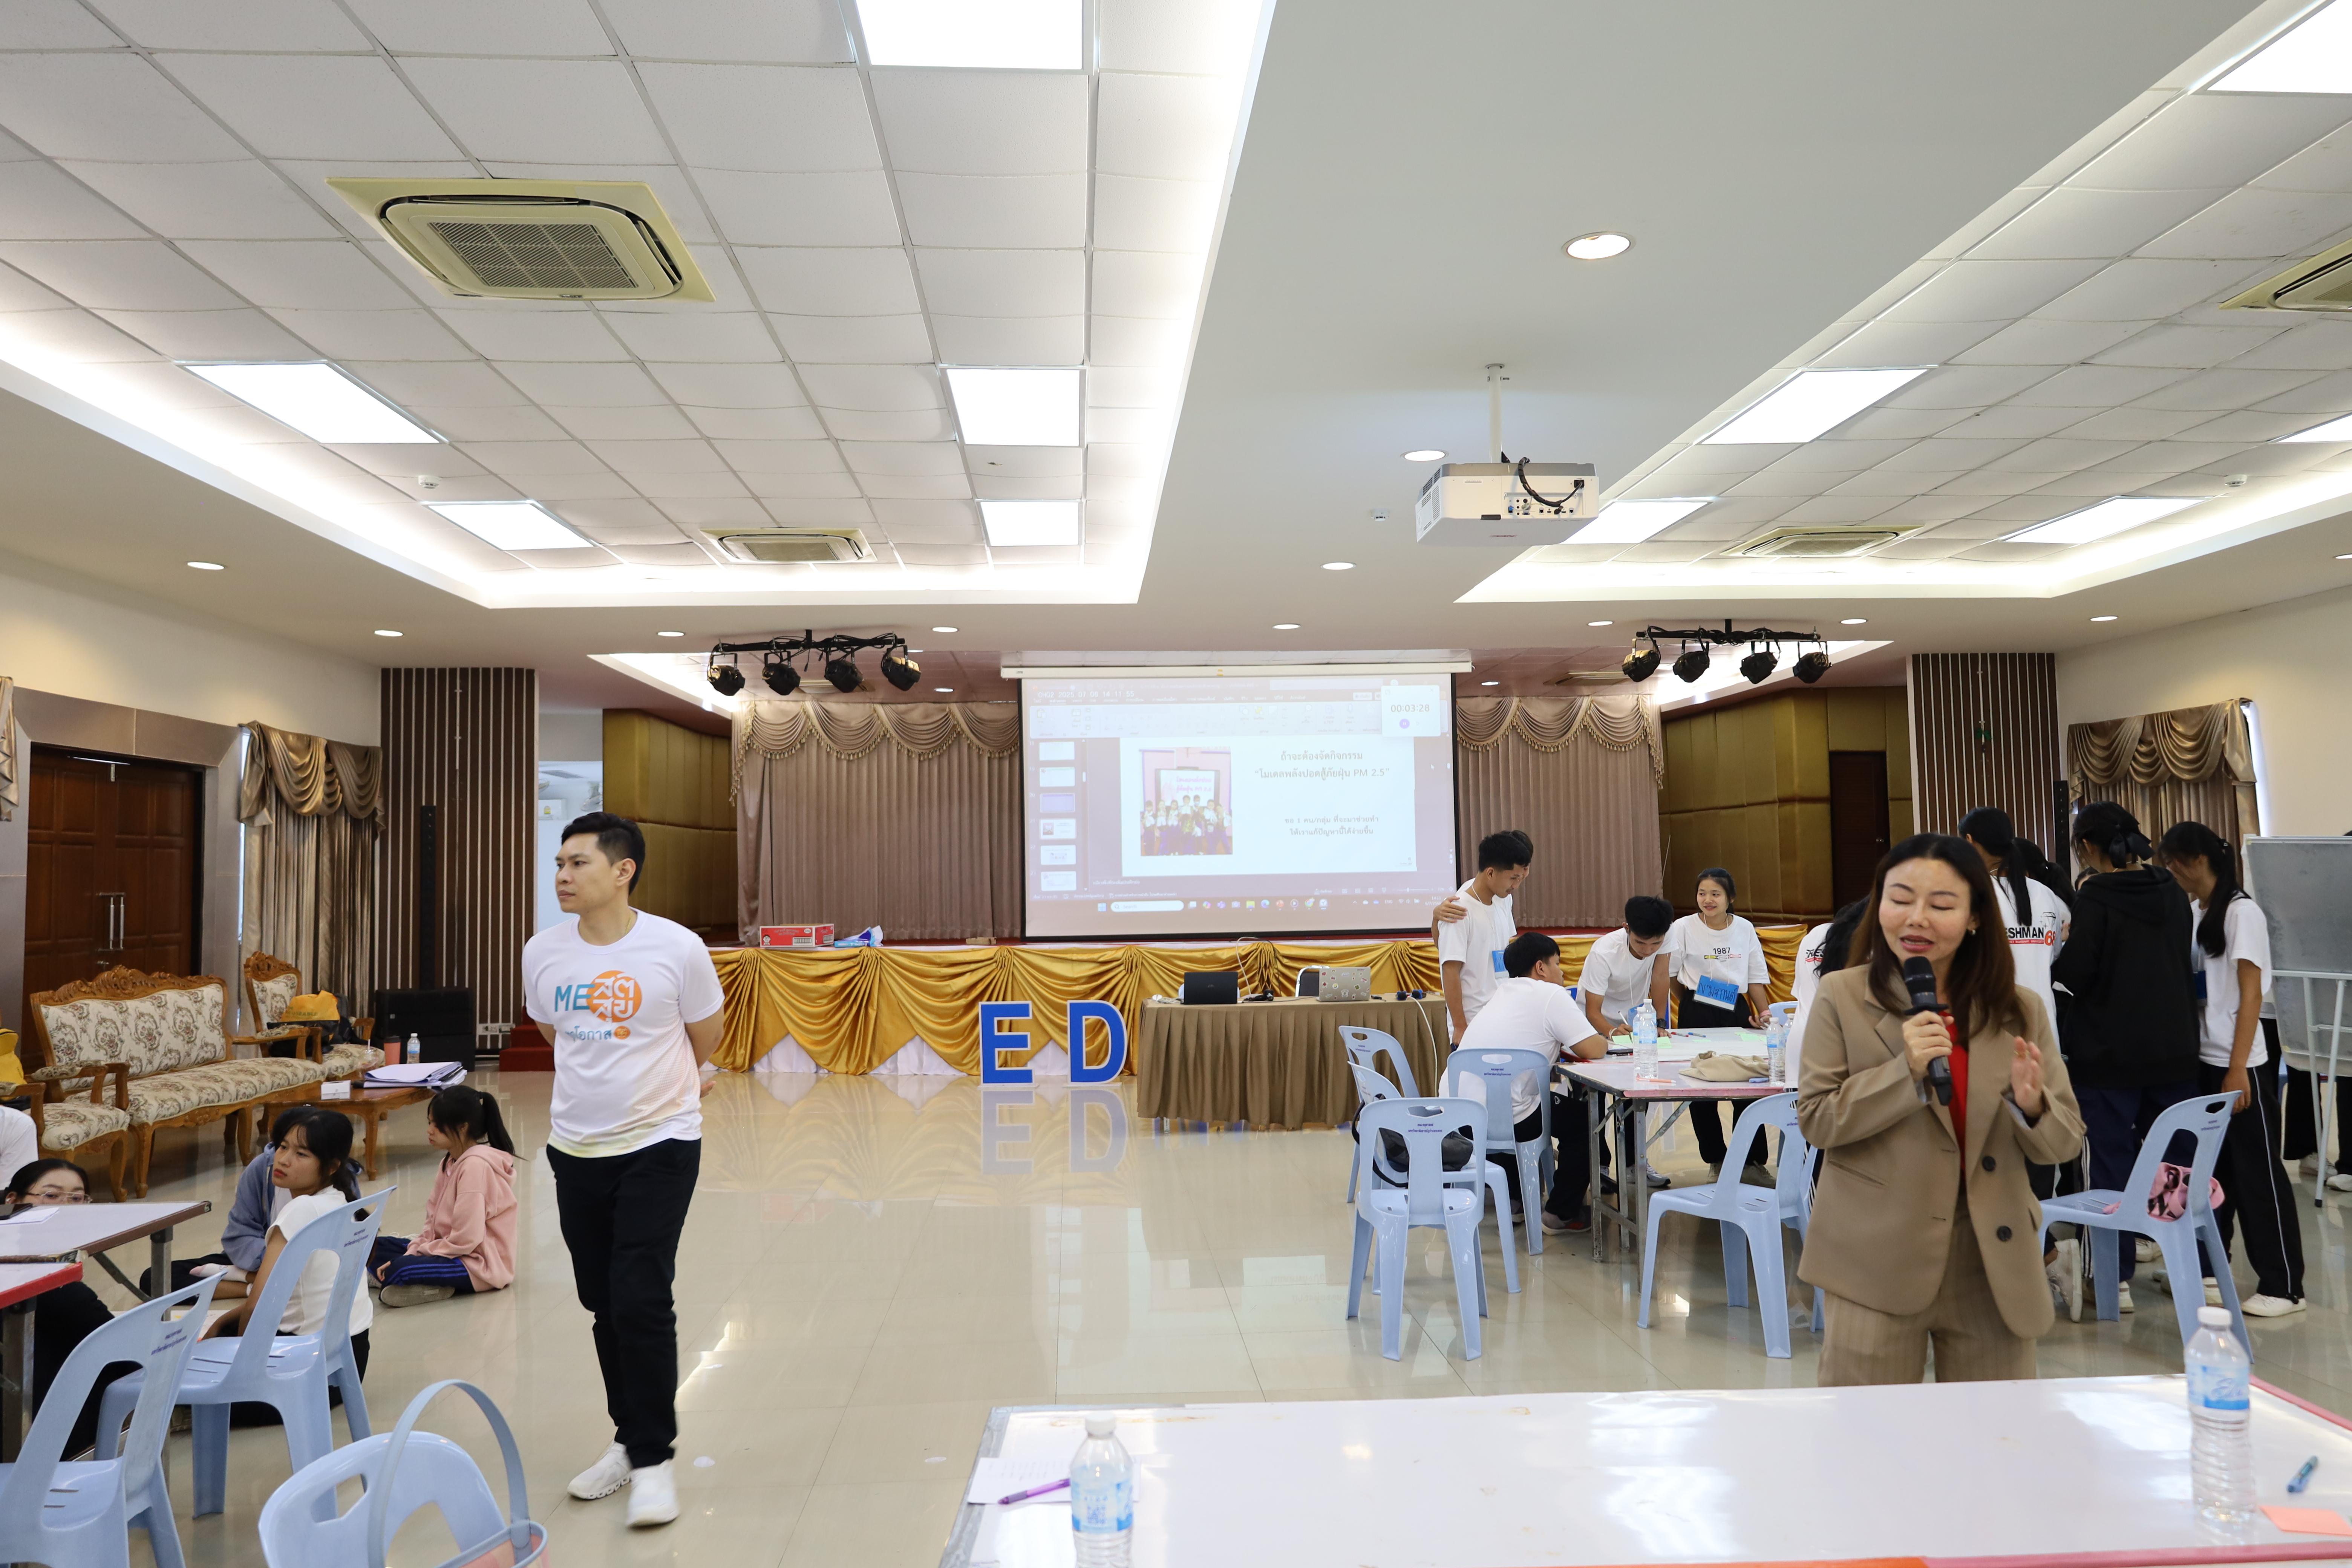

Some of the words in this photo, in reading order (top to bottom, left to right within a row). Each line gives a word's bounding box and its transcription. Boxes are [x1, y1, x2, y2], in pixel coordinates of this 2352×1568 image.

[1390, 704, 1430, 713] 00:03:28
[1280, 750, 1363, 761] ถ้าจะต้องจัดกิจกรรม
[1354, 769, 1367, 778] PM
[1303, 816, 1331, 825] คน/กลุ่ม
[2004, 927, 2044, 939] SHMAN
[555, 984, 596, 1012] ME
